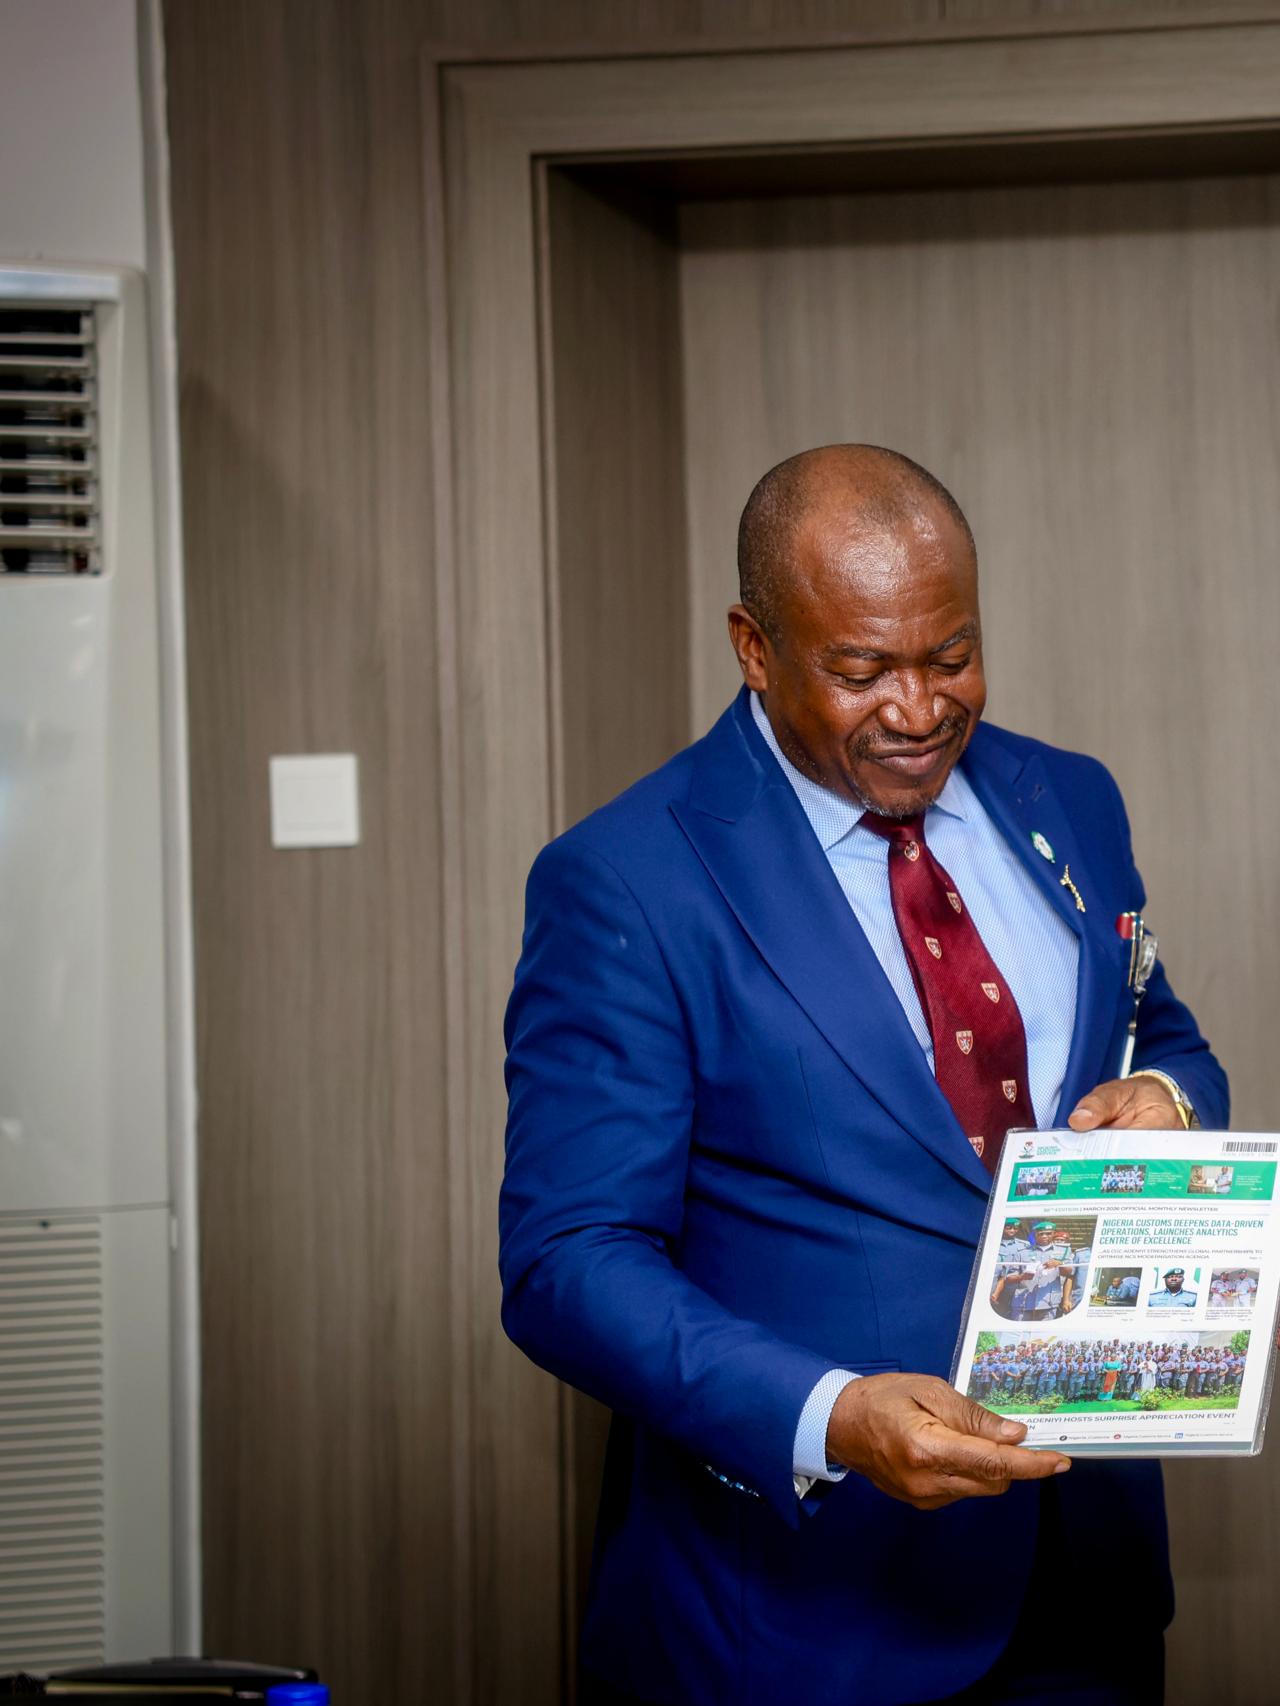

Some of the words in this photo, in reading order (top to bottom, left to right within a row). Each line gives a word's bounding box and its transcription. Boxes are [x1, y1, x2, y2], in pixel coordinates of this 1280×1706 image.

[1102, 1219, 1134, 1227] NIGERIA
[1135, 1219, 1172, 1227] CUSTOMS
[1173, 1219, 1210, 1228] DEEPENS
[1211, 1219, 1264, 1228] DATA-DRIVEN
[1100, 1227, 1151, 1236] OPERATIONS,
[1153, 1227, 1195, 1236] LAUNCHES
[1196, 1228, 1239, 1236] ANALYTICS
[1099, 1236, 1130, 1245] CENTRE
[1131, 1236, 1142, 1245] OF
[1143, 1236, 1192, 1245] EXCELLENCE
[1026, 1416, 1062, 1424] ADENIYI
[1063, 1415, 1093, 1423] HOSTS
[1094, 1414, 1137, 1422] SURPRISE
[1138, 1413, 1205, 1421] APPRECIATION
